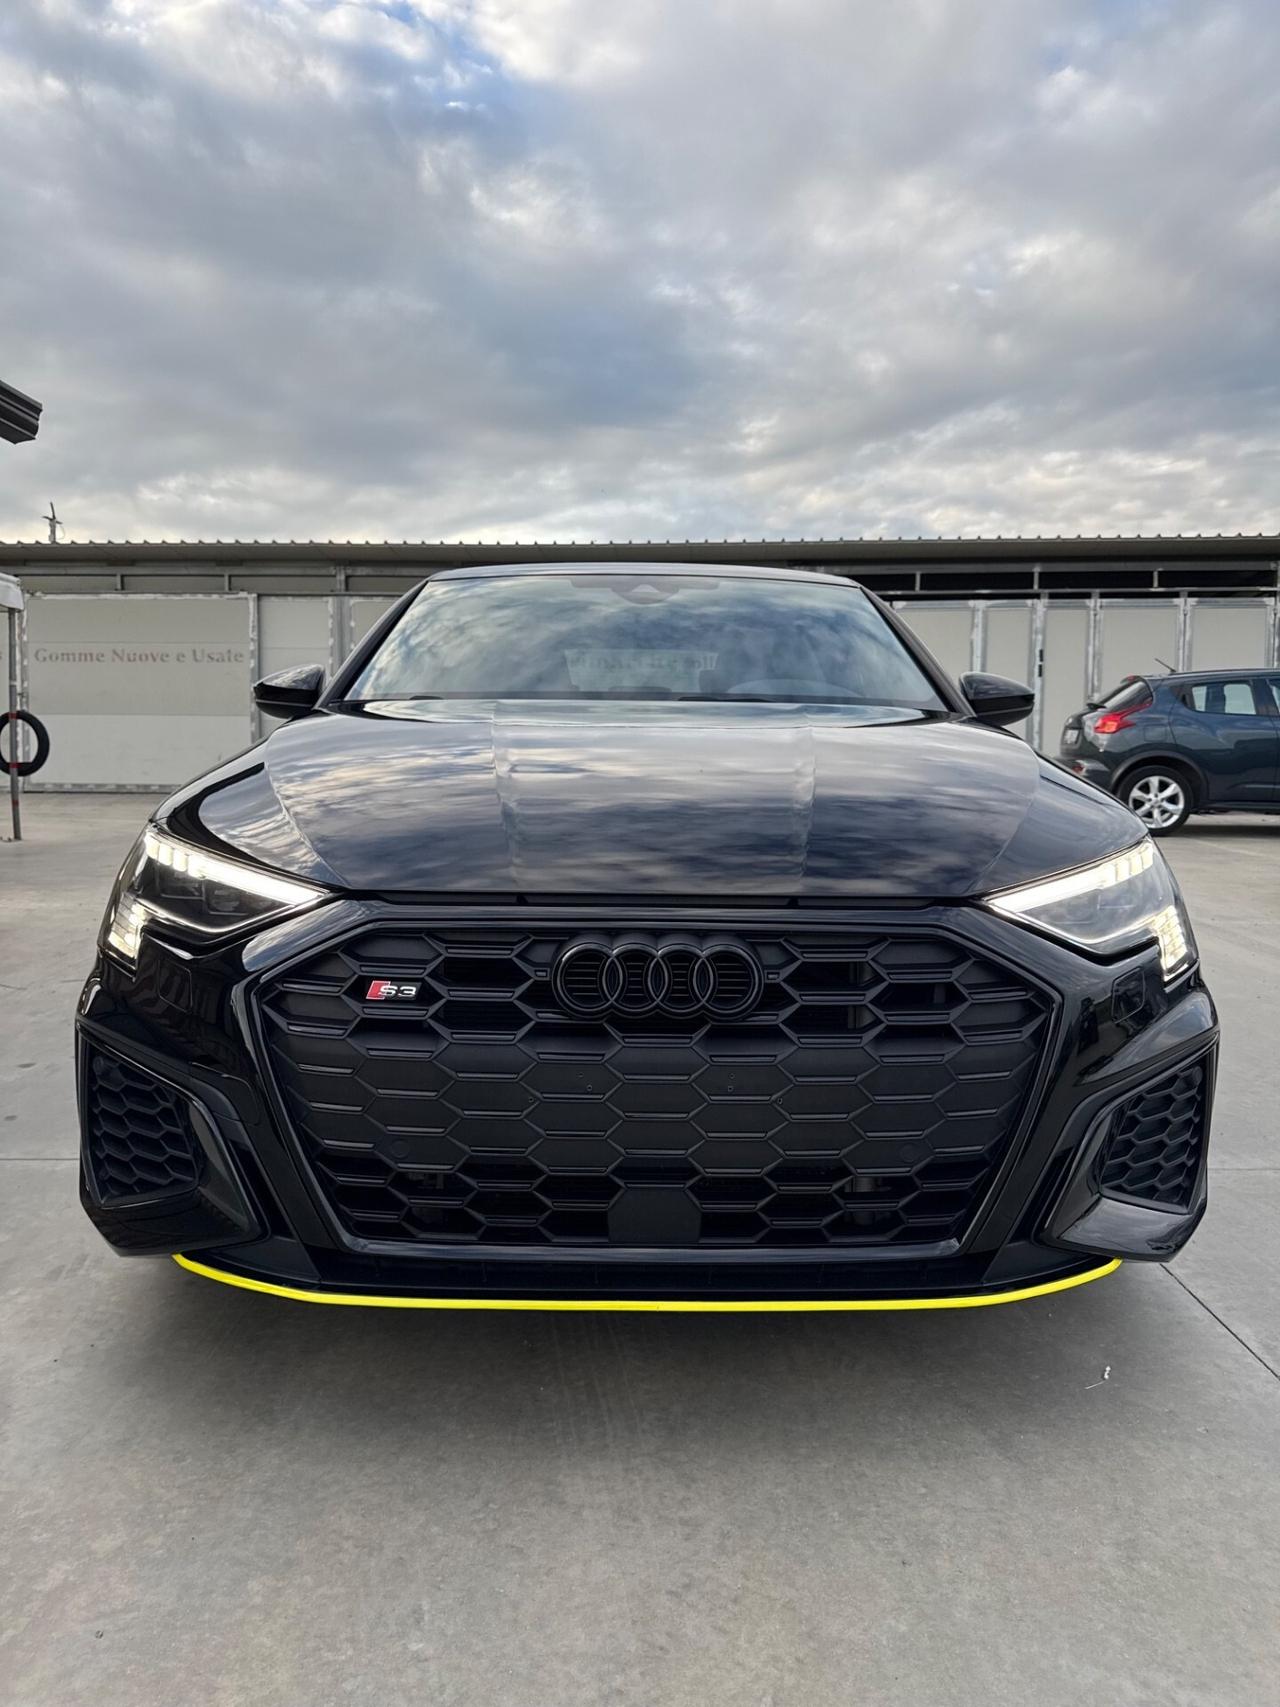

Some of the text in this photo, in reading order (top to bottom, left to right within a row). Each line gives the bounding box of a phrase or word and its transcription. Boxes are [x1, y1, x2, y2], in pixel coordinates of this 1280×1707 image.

[33, 647, 245, 664] Gomme Nuove e Usate
[377, 984, 418, 998] S3
